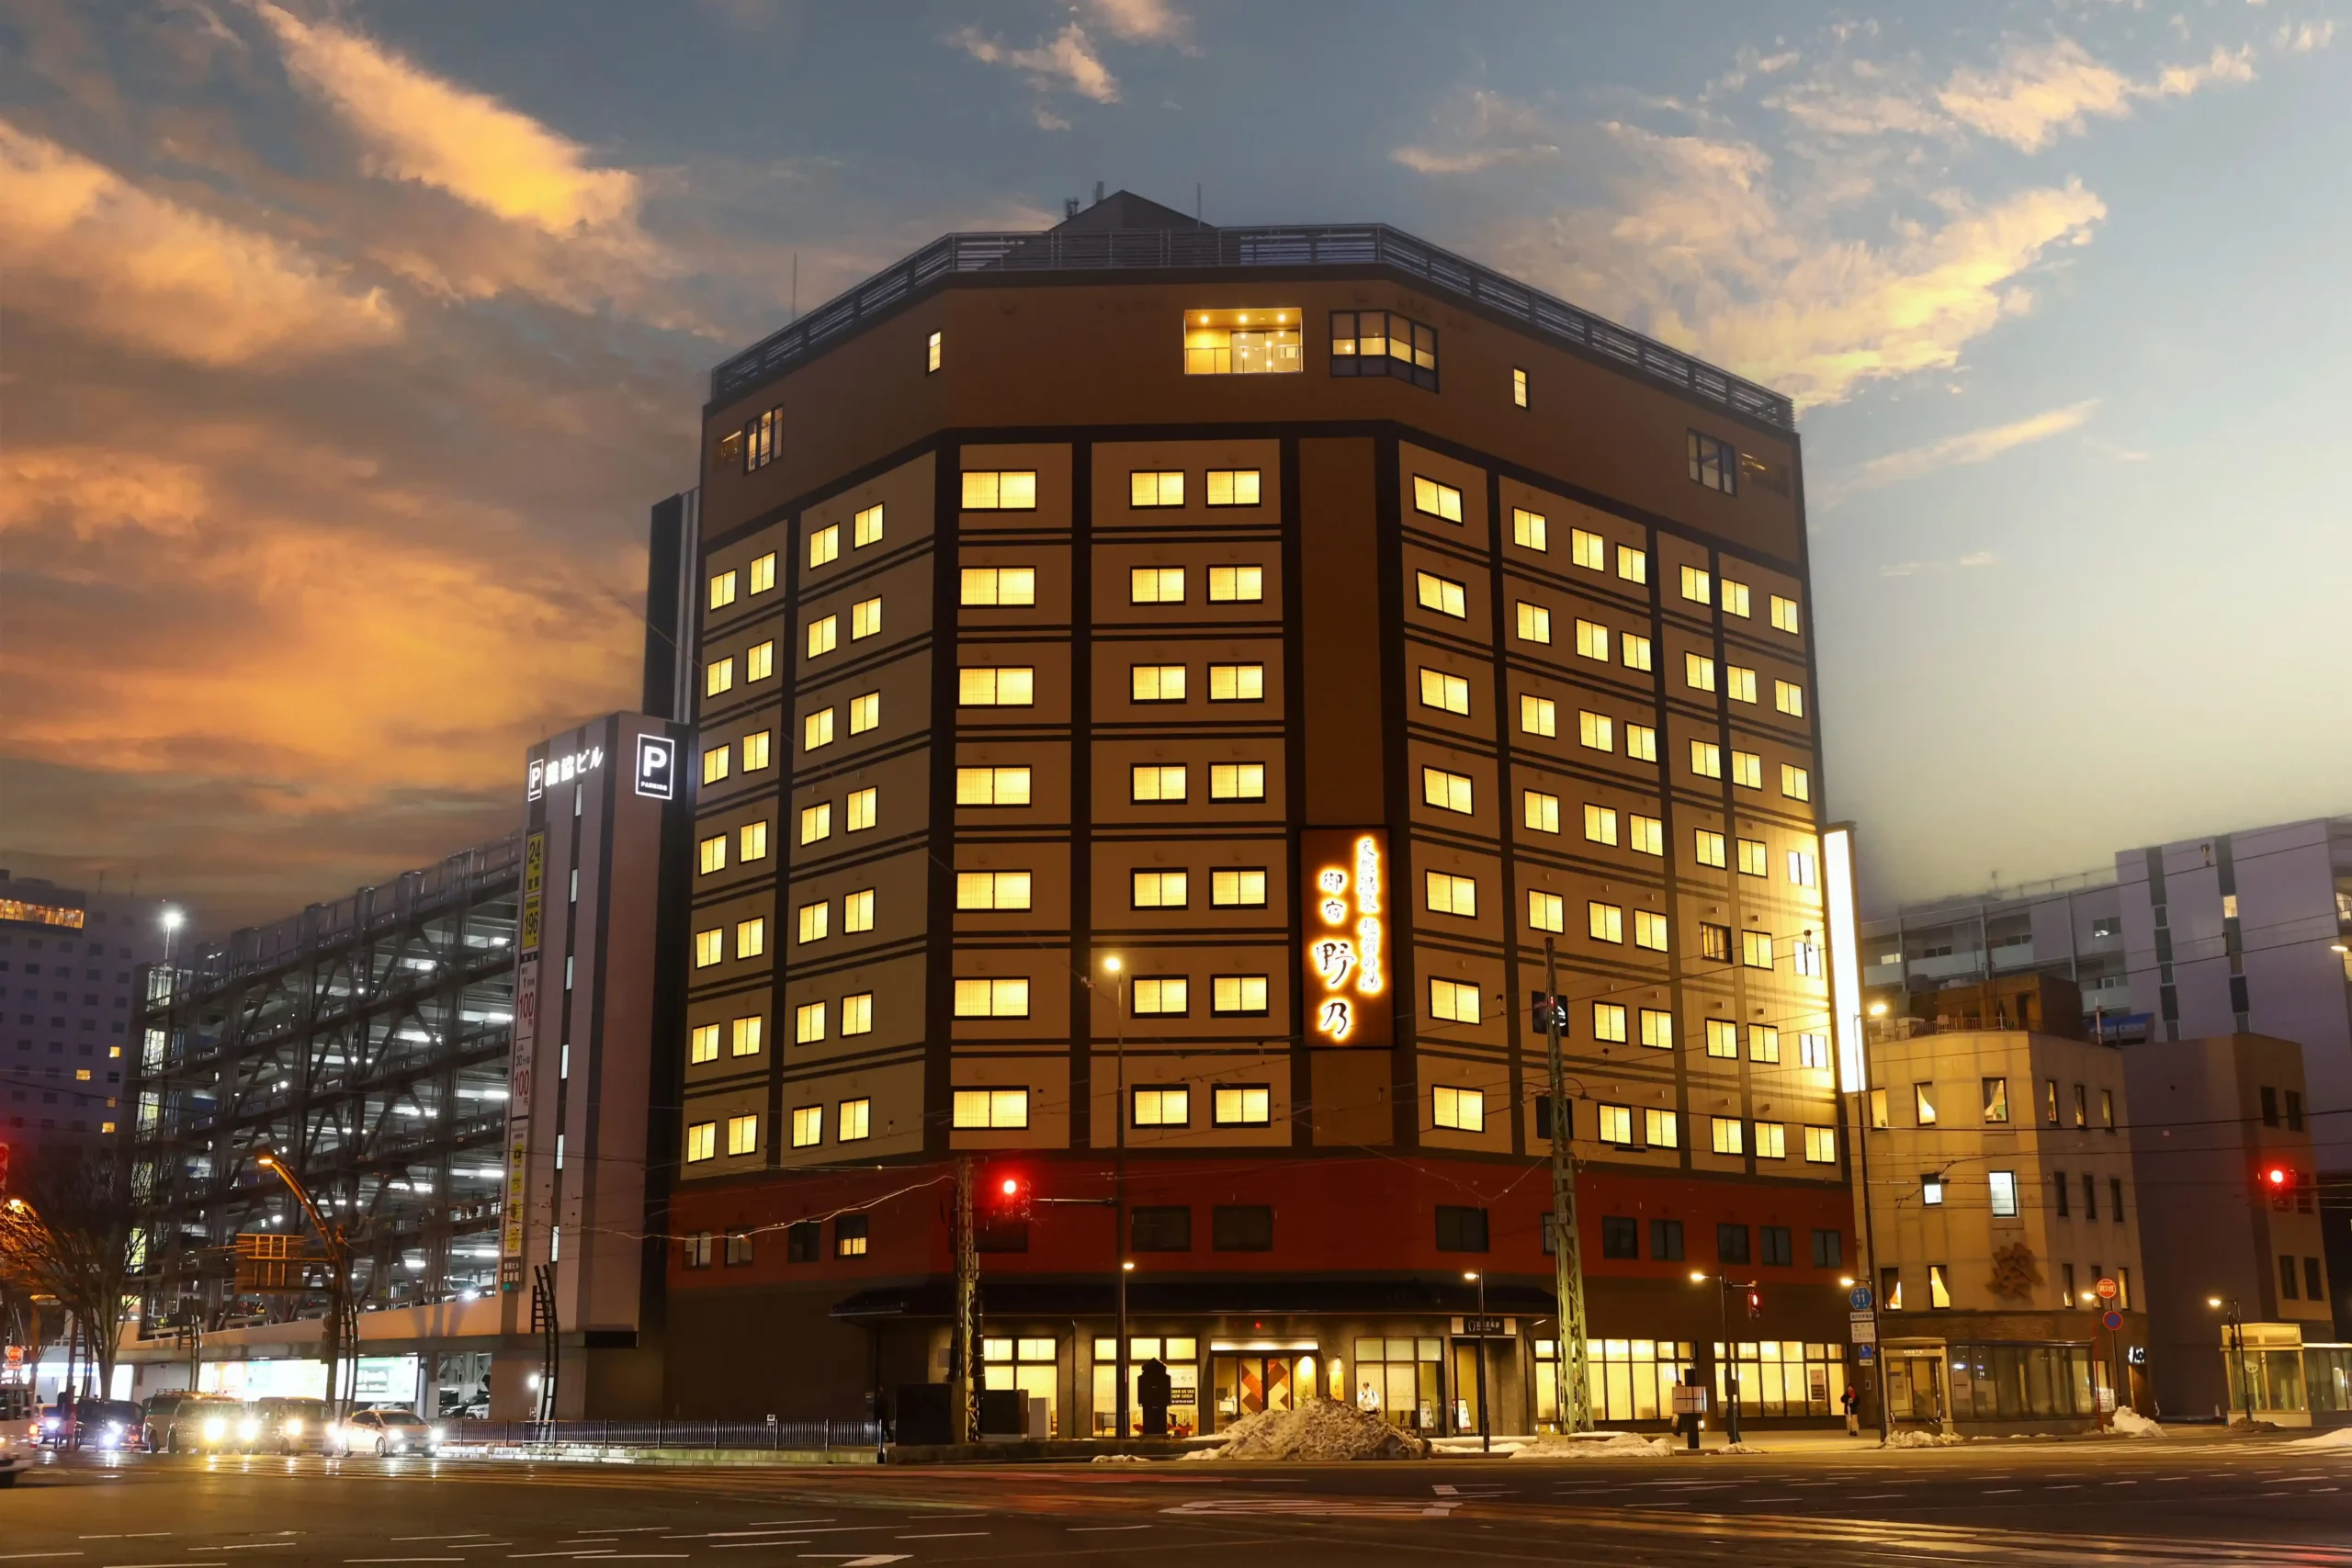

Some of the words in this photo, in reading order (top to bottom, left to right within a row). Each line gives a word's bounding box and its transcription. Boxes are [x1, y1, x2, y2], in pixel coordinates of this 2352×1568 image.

[643, 746, 667, 776] P
[531, 767, 541, 788] P
[640, 781, 668, 792] PARKING
[529, 840, 541, 863] 24
[525, 911, 538, 936] 196
[519, 992, 535, 1019] 100
[515, 1070, 530, 1098] 100
[1856, 1293, 1866, 1303] 11
